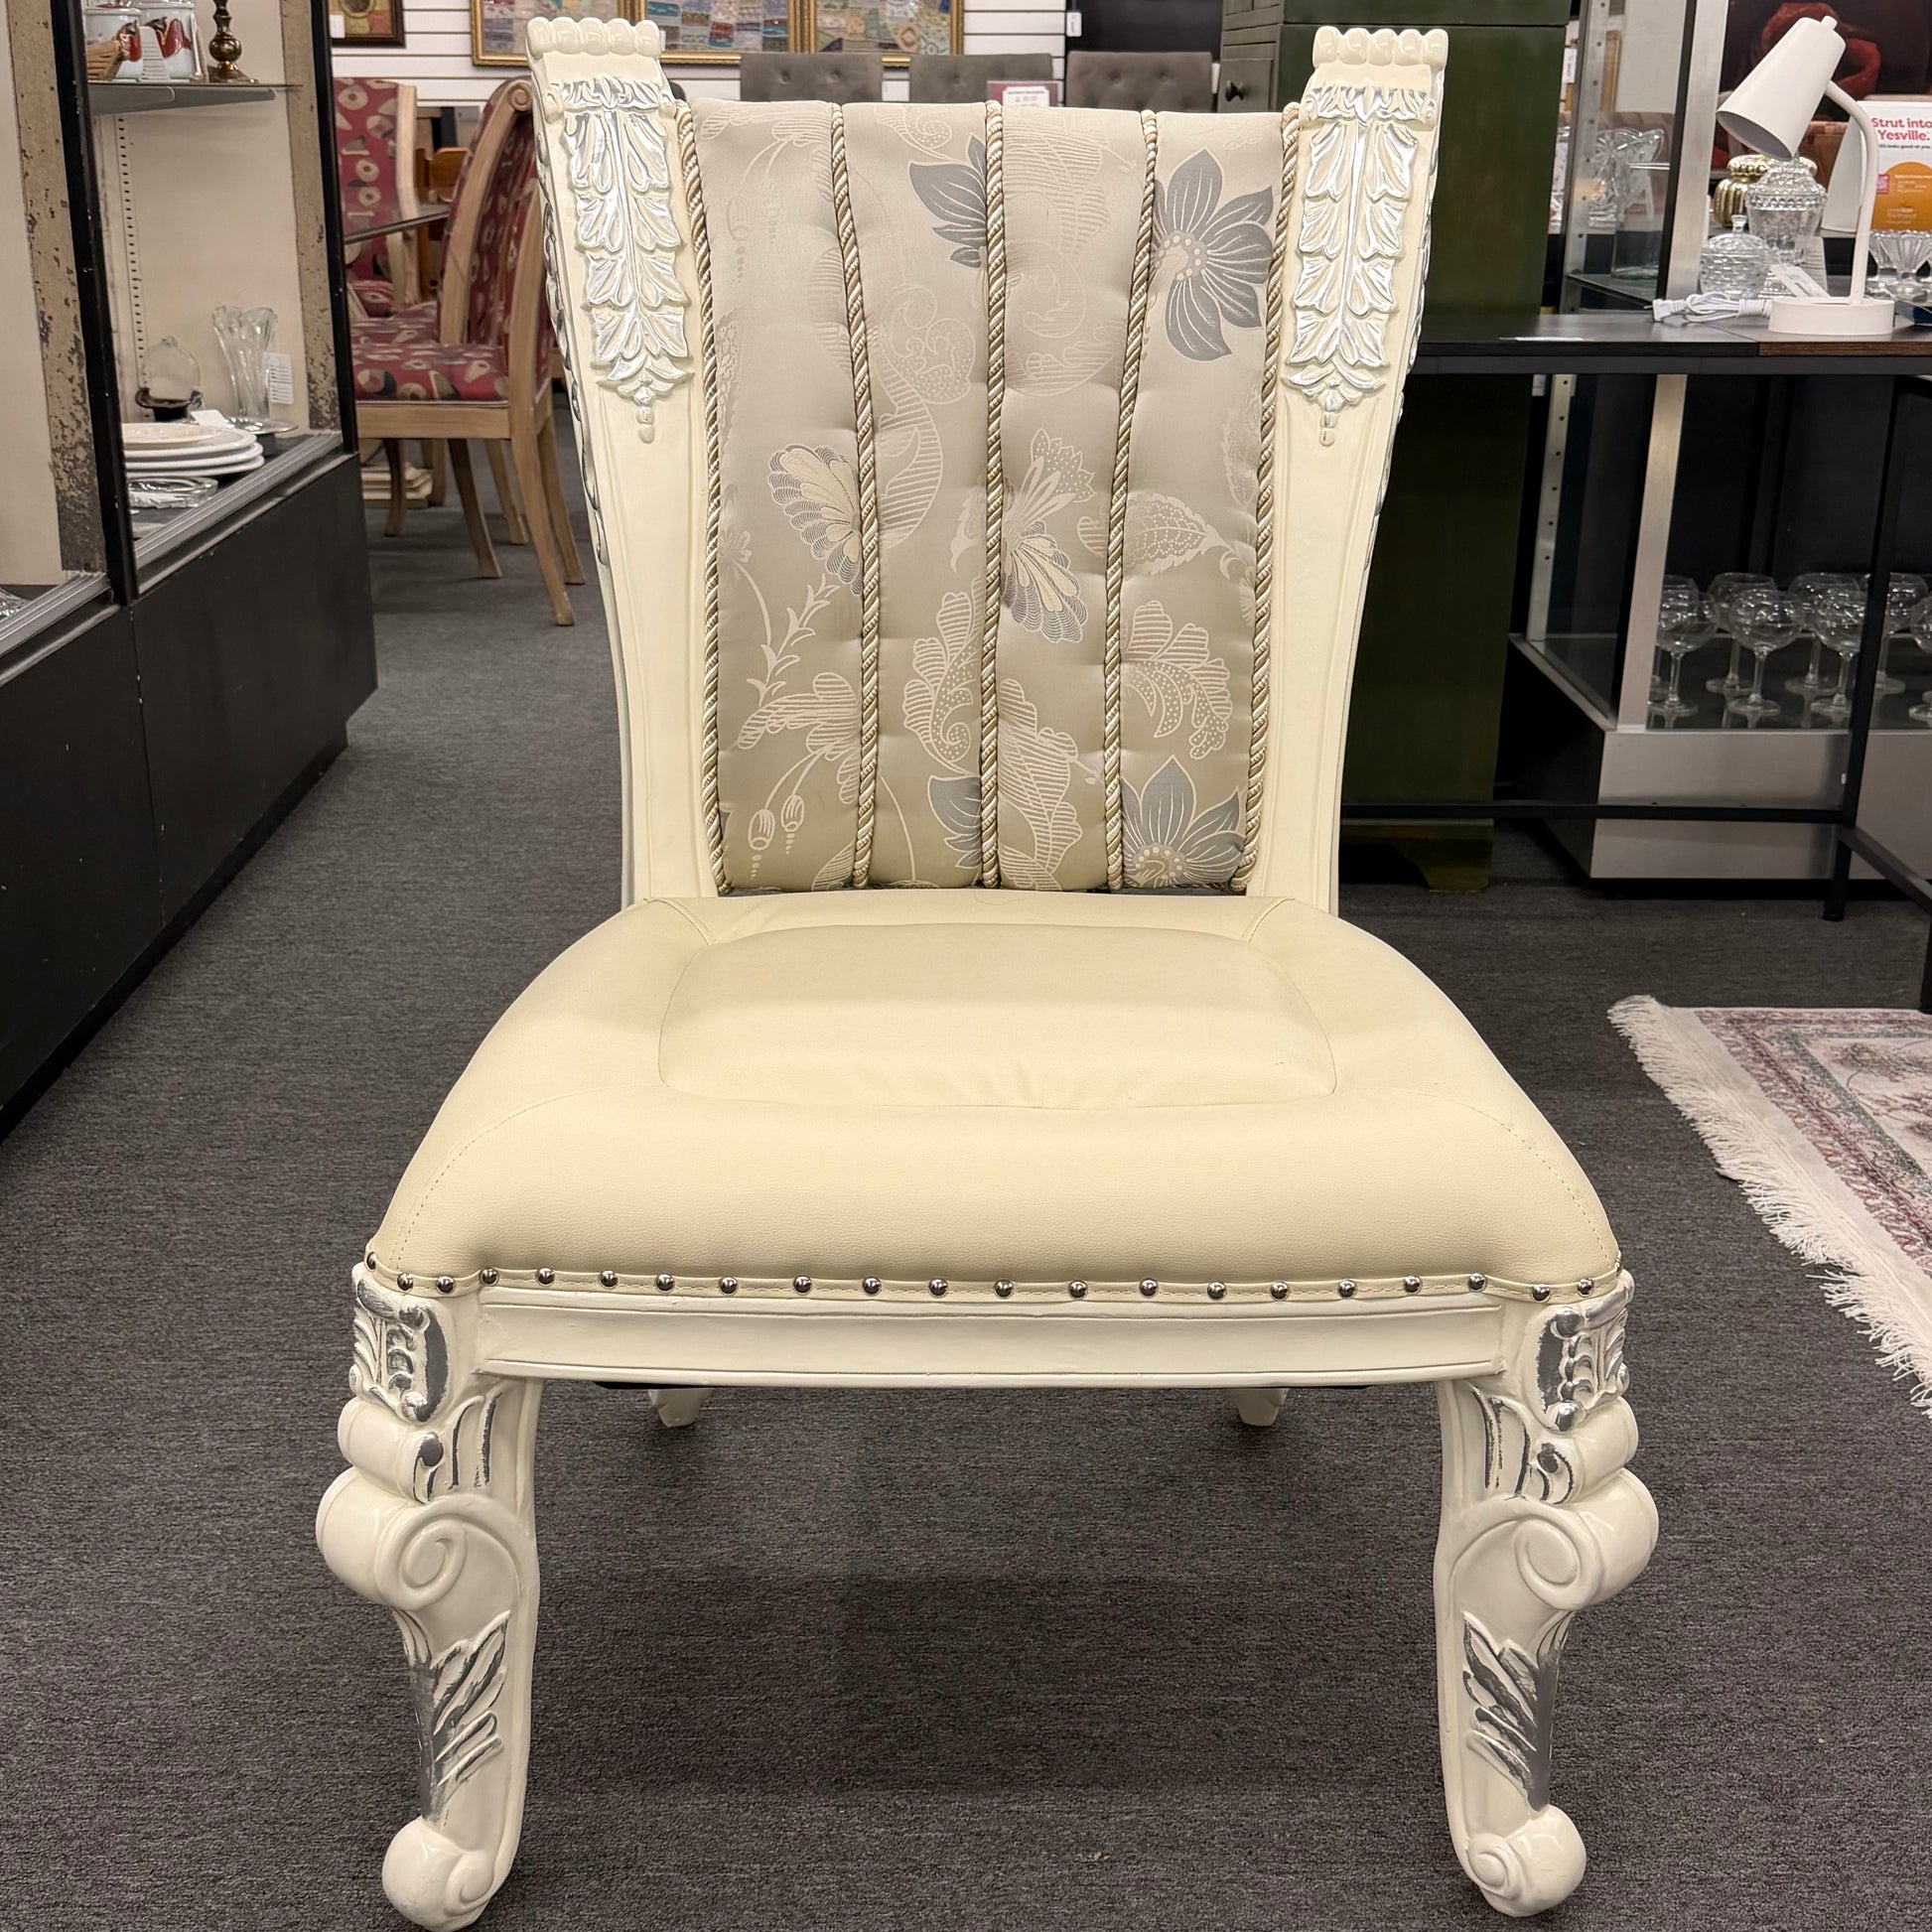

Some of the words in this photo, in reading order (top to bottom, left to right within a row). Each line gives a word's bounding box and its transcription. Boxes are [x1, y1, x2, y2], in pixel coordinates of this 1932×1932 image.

[1871, 117, 1905, 128] Strut
[1906, 117, 1932, 128] into
[1877, 129, 1930, 141] Yesville.
